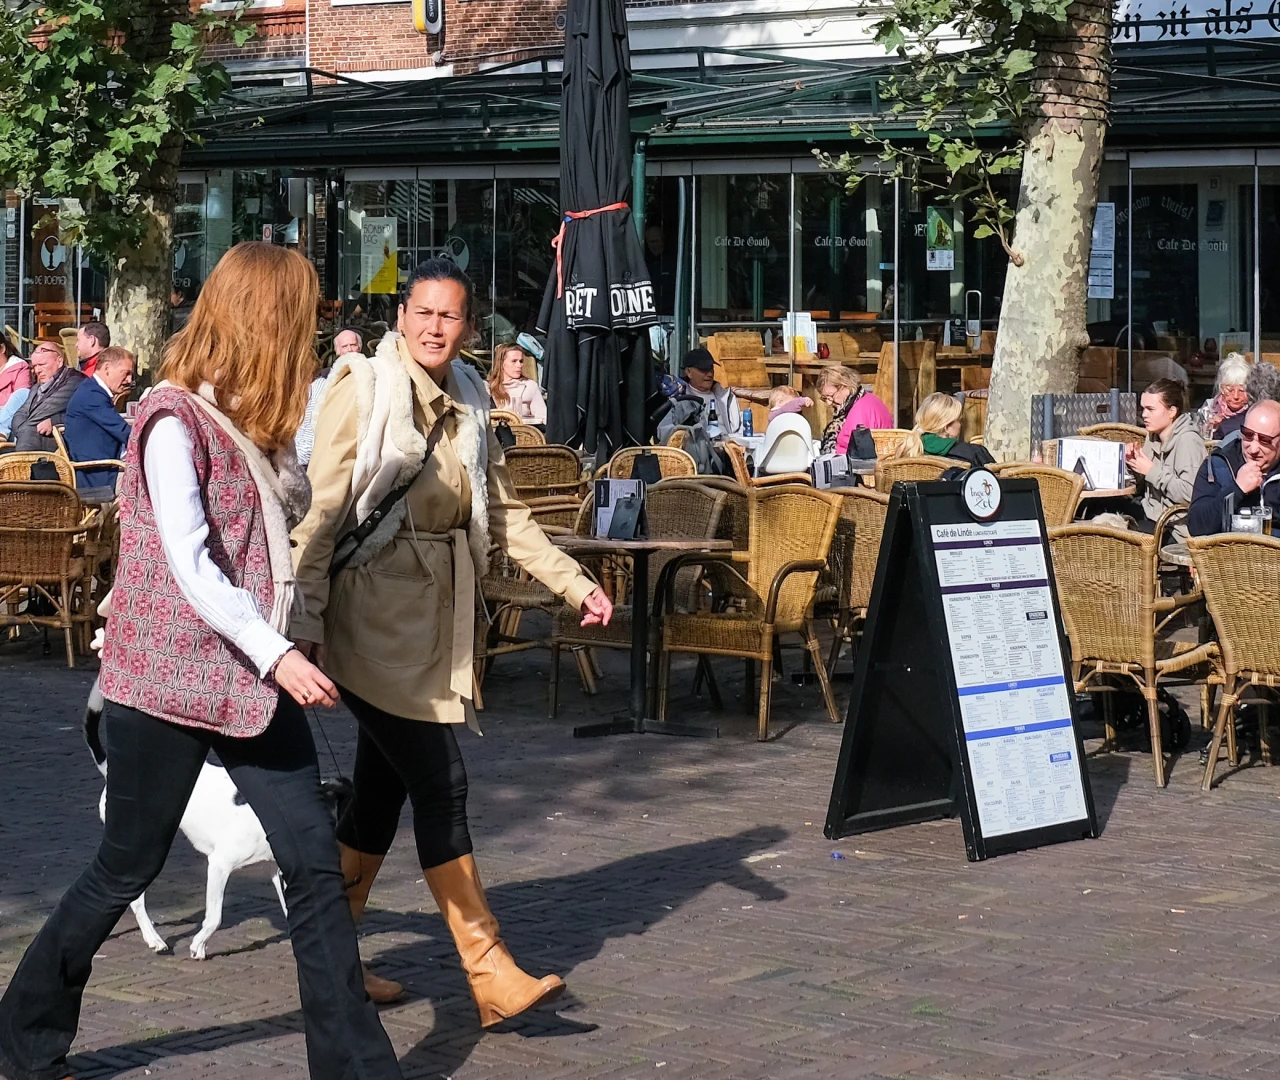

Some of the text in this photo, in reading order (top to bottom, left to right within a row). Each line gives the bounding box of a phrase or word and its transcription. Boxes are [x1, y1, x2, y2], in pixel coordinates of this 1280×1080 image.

[1156, 1, 1190, 40] zit
[1182, 239, 1196, 251] De
[936, 528, 949, 538] Café
[950, 529, 957, 537] de
[957, 528, 973, 537] Linde
